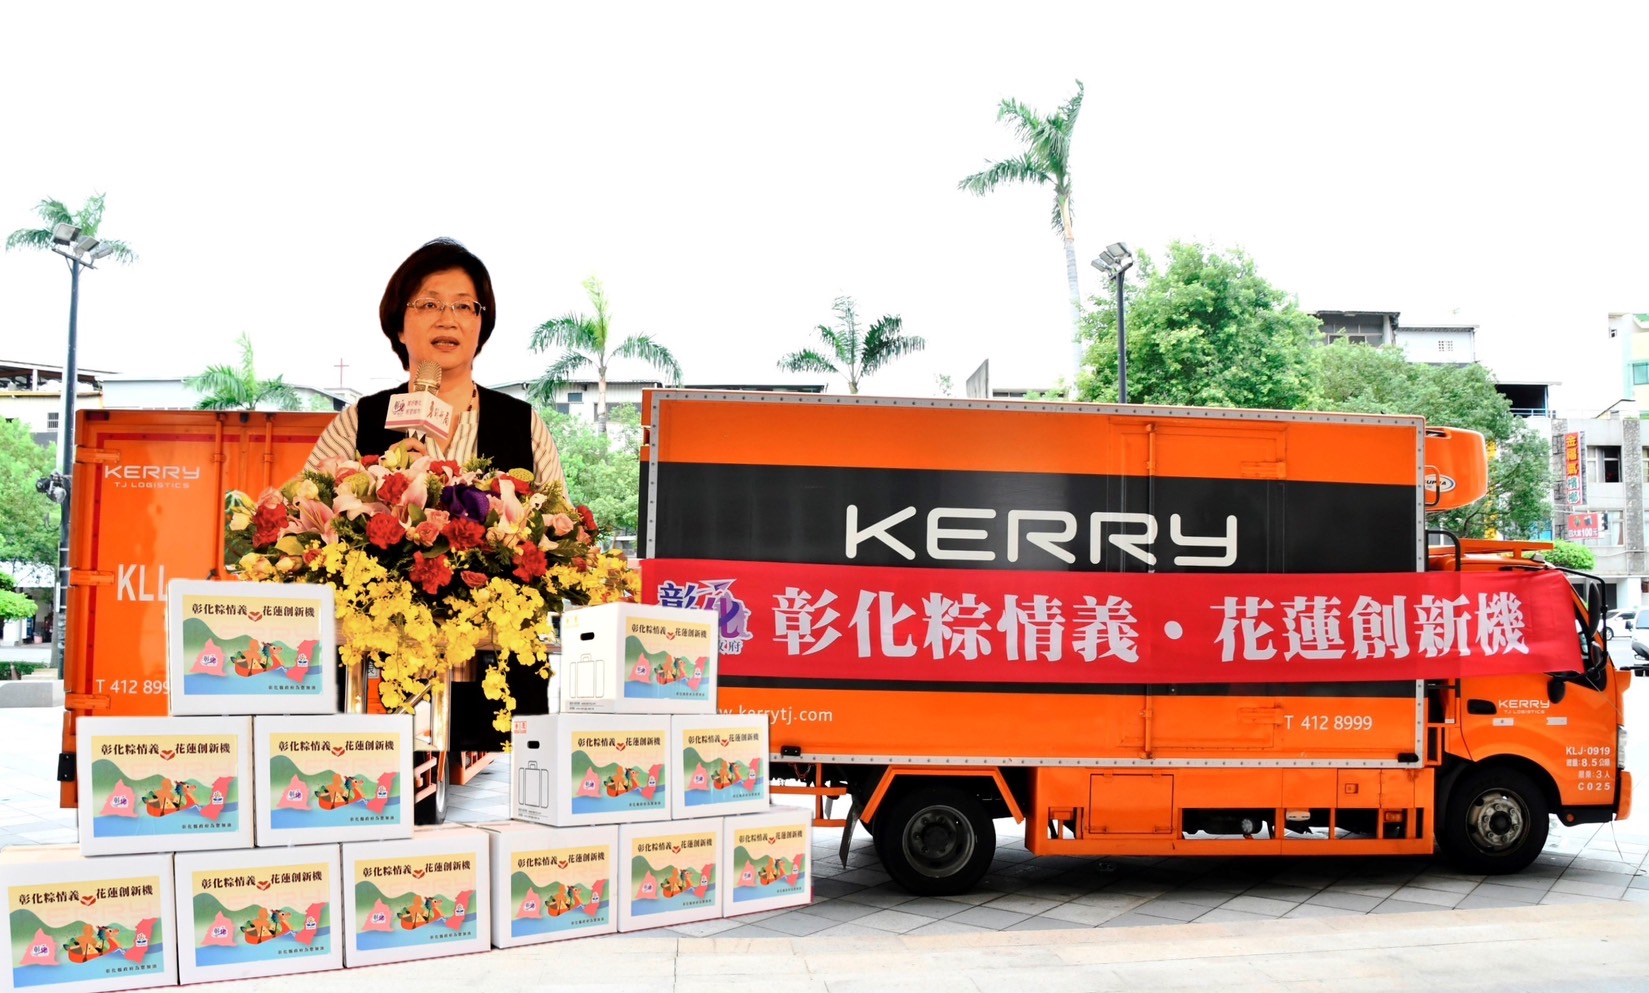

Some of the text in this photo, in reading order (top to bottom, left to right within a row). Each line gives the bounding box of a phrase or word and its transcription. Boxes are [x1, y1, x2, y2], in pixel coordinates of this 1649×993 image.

[104, 465, 200, 479] KERRY
[845, 504, 1238, 568] KERRY
[192, 603, 315, 617] 彰化粽情義 花蓮創新機
[631, 623, 707, 638] 彰化粽情義 花蓮創新機
[96, 679, 105, 693] T
[110, 680, 137, 694] 412
[1498, 699, 1550, 709] KERRY
[1284, 715, 1373, 730] T 412 8999
[101, 742, 231, 755] 彰化粽情義 花蓮創新機
[279, 740, 394, 751] 彰化粽情義 花蓮創新機
[578, 736, 661, 747] 彰化粽情義 花蓮創新機
[517, 852, 605, 868] 彰化粽情義 花蓮創新機
[363, 860, 471, 877] 彰化粽情義 花蓮創新機
[201, 871, 323, 889] 彰化粽情義 花蓮創新機
[19, 884, 153, 905] 彰化粽情義 花蓮創新機
